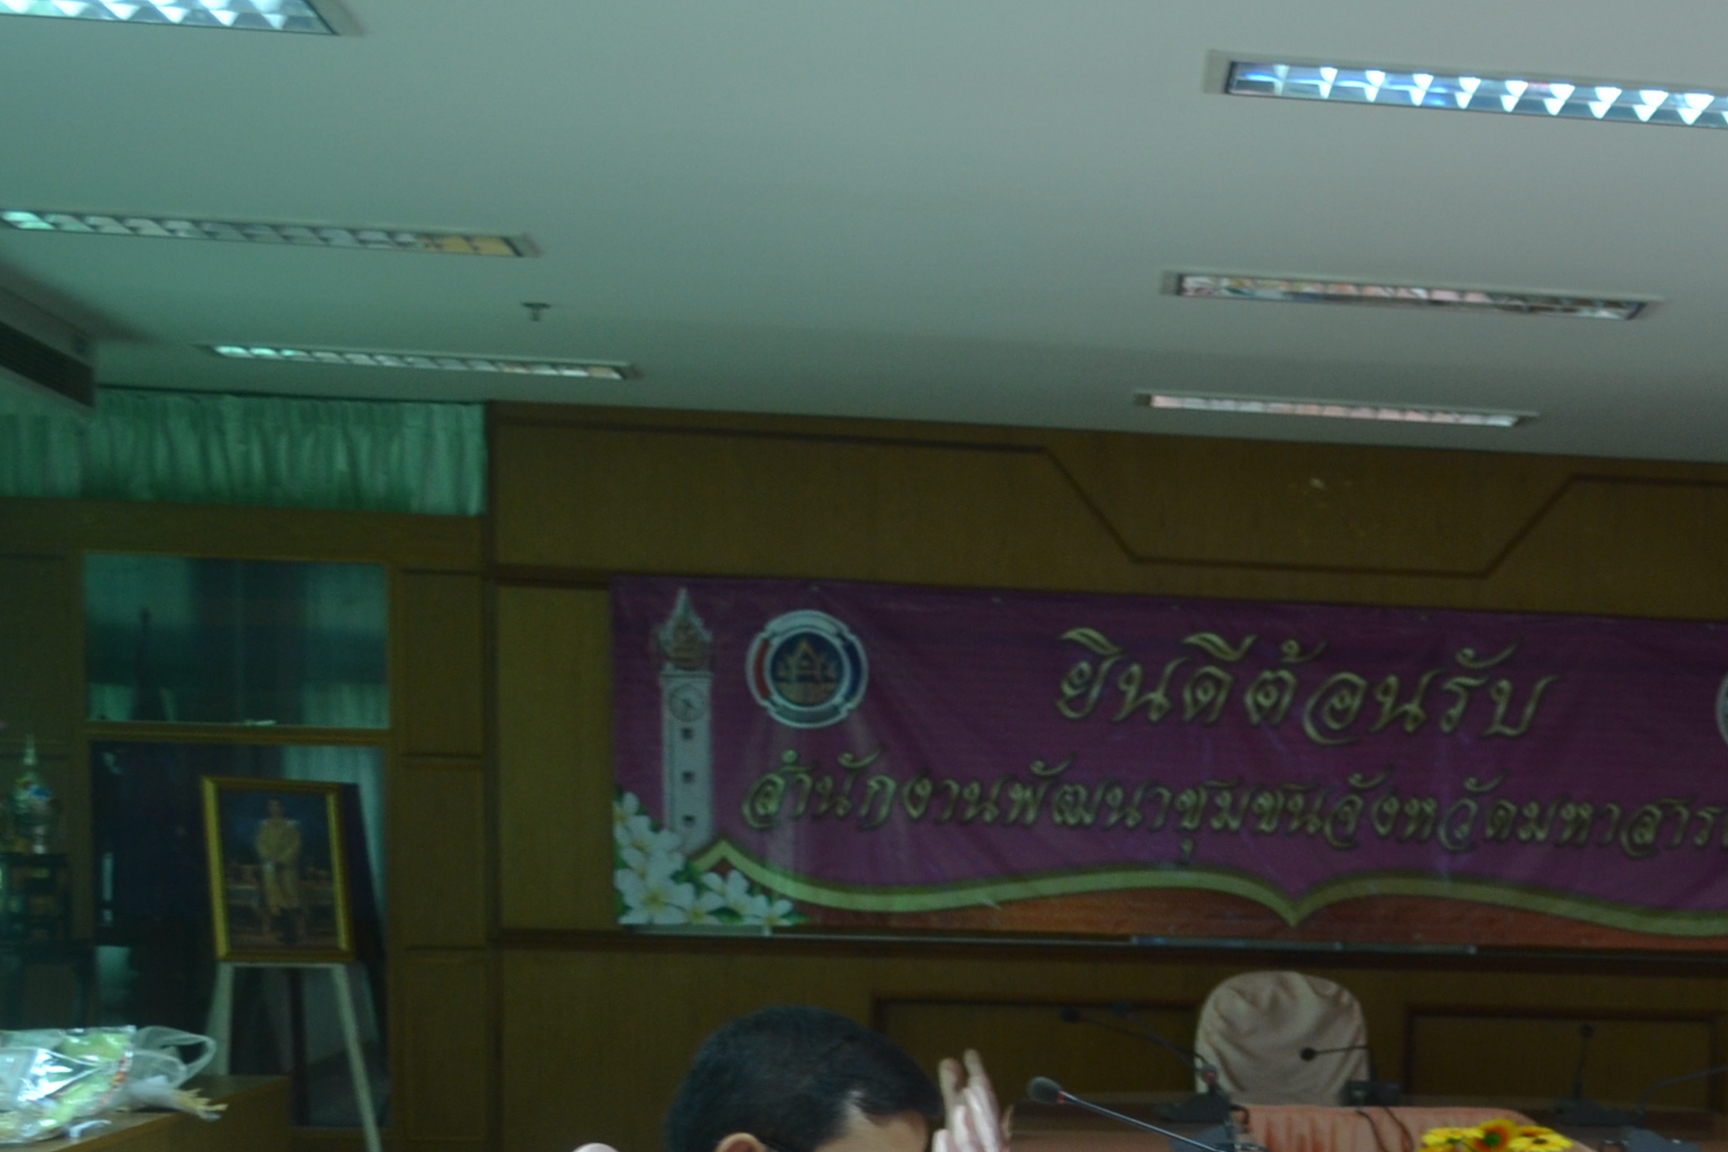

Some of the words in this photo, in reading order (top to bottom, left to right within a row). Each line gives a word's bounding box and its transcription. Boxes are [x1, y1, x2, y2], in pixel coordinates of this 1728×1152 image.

[1055, 627, 1561, 747] ยินดีต้อนรับ
